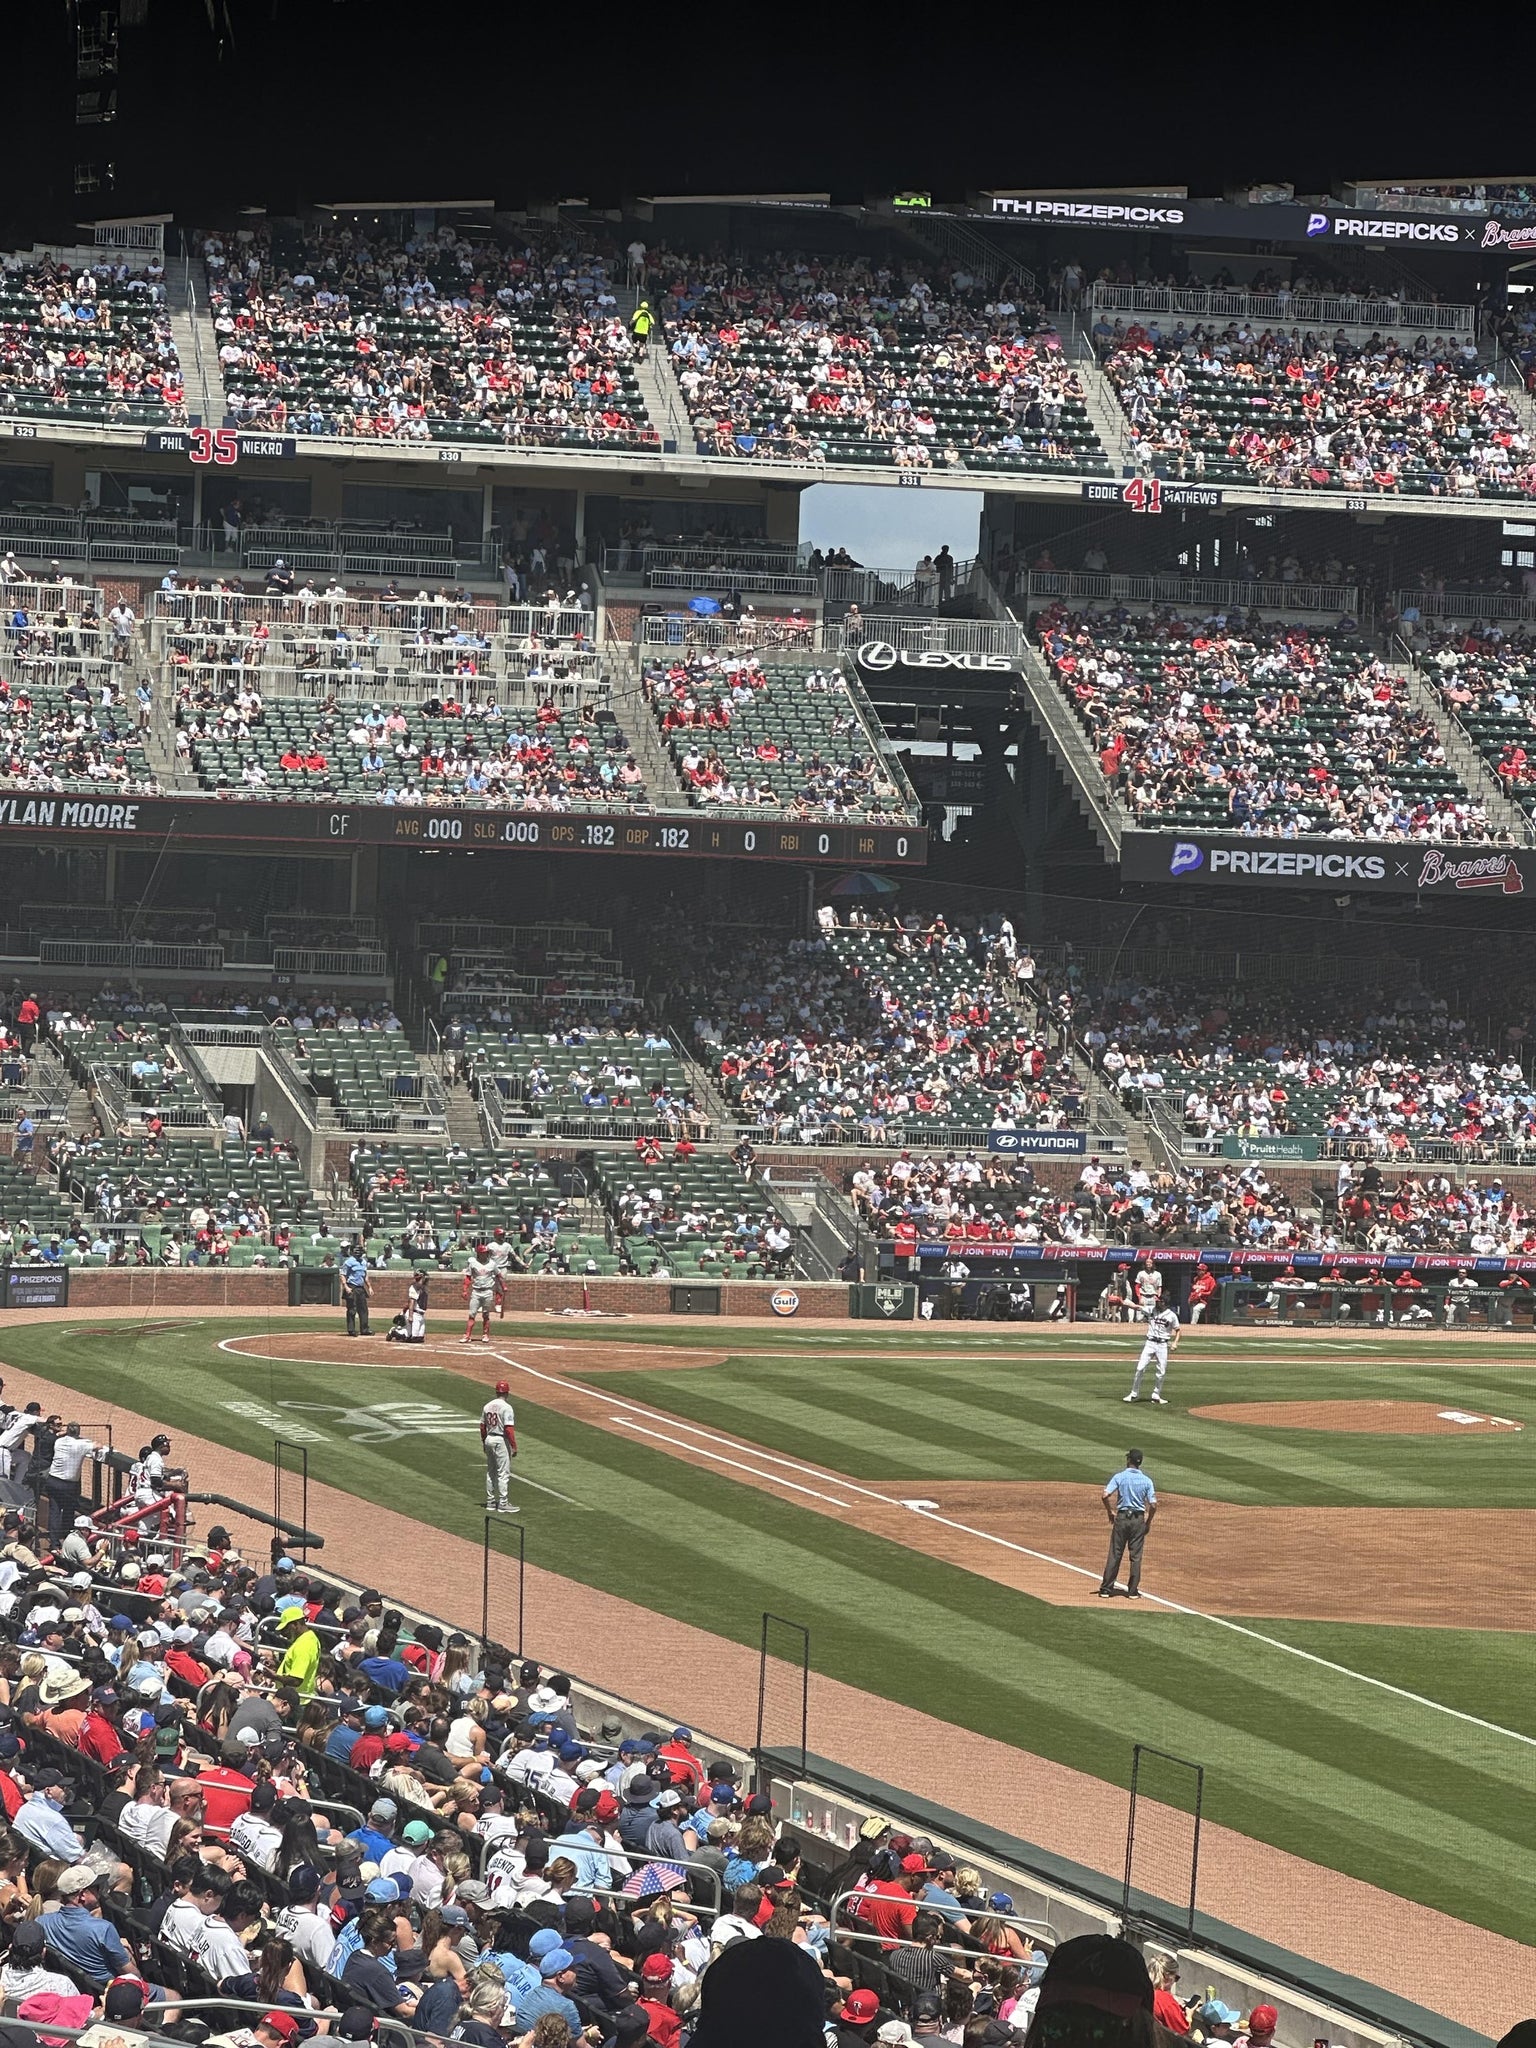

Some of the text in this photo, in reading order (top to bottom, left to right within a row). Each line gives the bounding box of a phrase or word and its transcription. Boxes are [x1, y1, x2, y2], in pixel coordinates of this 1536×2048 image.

[1035, 200, 1184, 224] PRIZEPICKS
[1334, 218, 1458, 242] PRIZEPICKS
[16, 427, 34, 437] 329
[160, 427, 283, 465] PHIL 35 NIEKRO
[441, 451, 459, 461] 330
[901, 476, 918, 485] 331
[1088, 478, 1217, 513] EDDIE 41 MATHEWS
[1348, 500, 1365, 510] 333
[901, 650, 1012, 671] LEXUS
[60, 803, 139, 830] MOORE
[330, 814, 350, 836] CF
[396, 818, 907, 857] AVG .000 SLG .000 OPS .182 OBP .182 H 0 RBI 0 HR 0
[1210, 850, 1385, 879] PRIZEPICKS
[1418, 849, 1507, 887] Braves
[1021, 1137, 1079, 1149] HYUNDAI
[964, 1248, 985, 1256] JOIN
[1086, 1250, 1103, 1258] FUN
[1153, 1252, 1173, 1260] JOIN
[1247, 1254, 1266, 1262] JOIN
[1273, 1255, 1289, 1263] FUN
[1338, 1256, 1358, 1264] JOIN
[1365, 1257, 1381, 1265] FUN
[1457, 1259, 1473, 1267] FUN
[20, 1275, 62, 1283] PRIZEPICKS
[877, 1288, 901, 1296] MLB
[774, 1297, 797, 1305] Gulf
